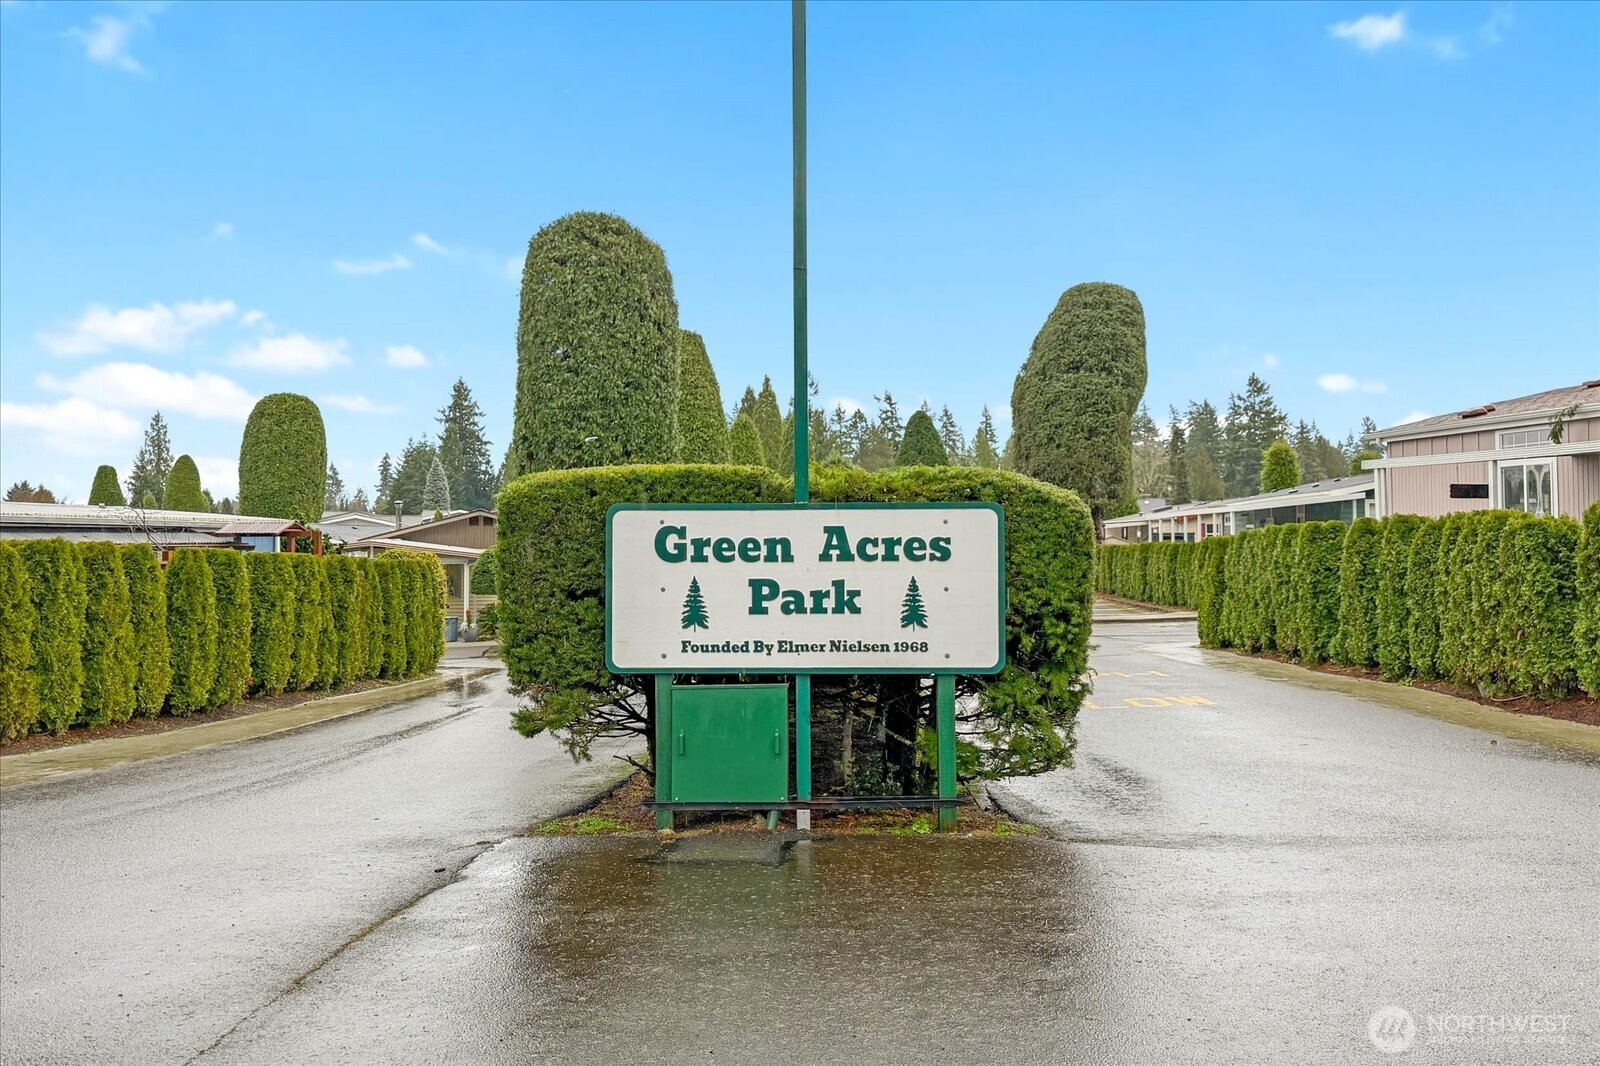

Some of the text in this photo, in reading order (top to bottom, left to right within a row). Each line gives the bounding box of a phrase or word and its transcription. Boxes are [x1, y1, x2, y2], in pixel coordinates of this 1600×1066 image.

[654, 525, 952, 564] Green Acres
[748, 578, 862, 616] Park
[681, 640, 929, 656] Founded By Elmer Nielsen 1968
[1082, 695, 1217, 710] LOW
